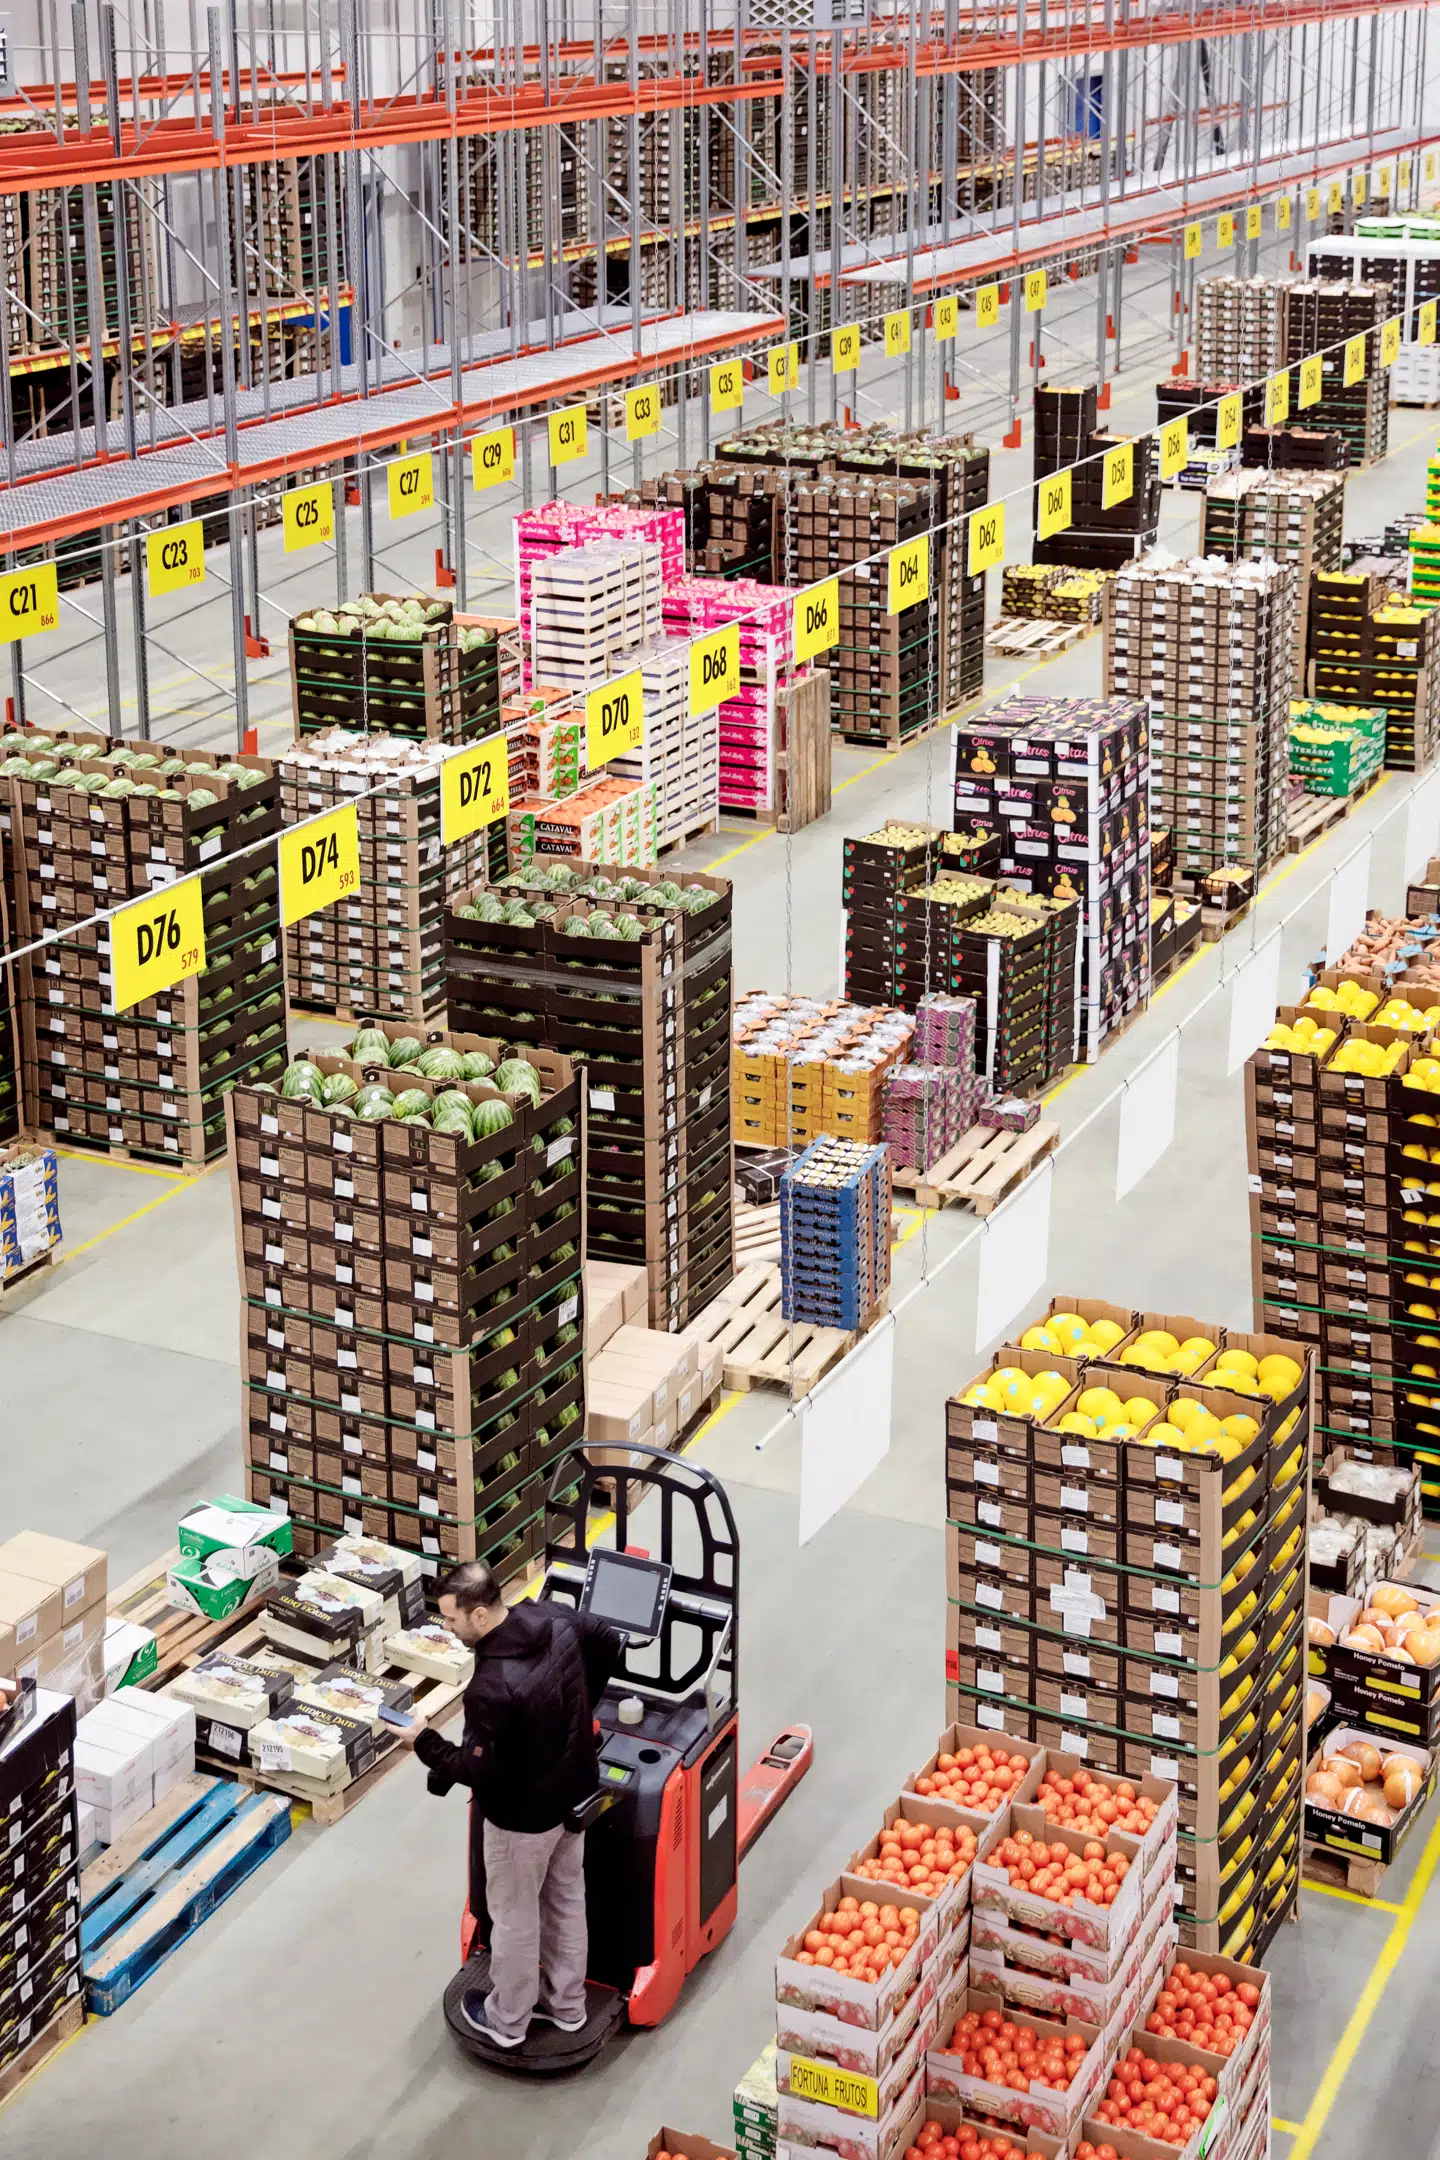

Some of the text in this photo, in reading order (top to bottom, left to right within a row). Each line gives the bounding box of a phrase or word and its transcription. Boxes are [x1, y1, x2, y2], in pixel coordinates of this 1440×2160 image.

[839, 336, 852, 356] C39
[718, 372, 733, 394] C35
[634, 396, 650, 421] C33
[559, 420, 575, 444] C31
[482, 442, 502, 469] C29
[1168, 432, 1180, 458] D56
[400, 468, 420, 496] C27
[1112, 458, 1126, 486] D58
[1048, 486, 1063, 516] D60
[296, 499, 318, 528] C25
[320, 526, 330, 537] 100
[979, 519, 996, 550] D62
[162, 539, 188, 570] C23
[188, 567, 202, 580] 703
[900, 554, 918, 588] D64
[10, 583, 38, 616] C21
[40, 614, 54, 626] 866
[806, 598, 828, 635] D66
[703, 646, 728, 685] D68
[602, 693, 629, 737] D70
[628, 726, 640, 743] 132
[972, 736, 995, 748] Citrus
[1294, 746, 1335, 757] TEKASYA
[460, 761, 492, 808] D72
[1052, 786, 1076, 797] Citrus
[491, 796, 504, 814] 664
[540, 822, 573, 834] CATAVAL
[970, 818, 994, 828] Citrus
[300, 832, 339, 885] D74
[540, 842, 574, 853] CATAVAL
[339, 870, 354, 890] 593
[1054, 864, 1079, 875] Citrus
[136, 908, 182, 967] D76
[181, 948, 199, 970] 579
[437, 1138, 455, 1148] Brazil
[359, 1170, 378, 1181] Brazil
[814, 1260, 840, 1268] PHYSALIS
[814, 1290, 840, 1298] PHYSALIS
[364, 1302, 382, 1312] Brazil
[814, 1317, 840, 1325] PHYSALIS
[219, 1656, 279, 1679] MEDJOUL DATES
[1353, 1650, 1406, 1672] Honey Pomelo
[338, 1666, 400, 1691] MEDJOUL DATES
[1354, 1686, 1406, 1706] Honey Pomelo
[296, 1704, 358, 1729] MEDJOUL DATES
[213, 1724, 234, 1740] 212196
[262, 1744, 284, 1753] 212195
[1312, 1808, 1366, 1830] Honey Pomelo
[792, 2066, 867, 2108] FORTUNA FRUTOS
